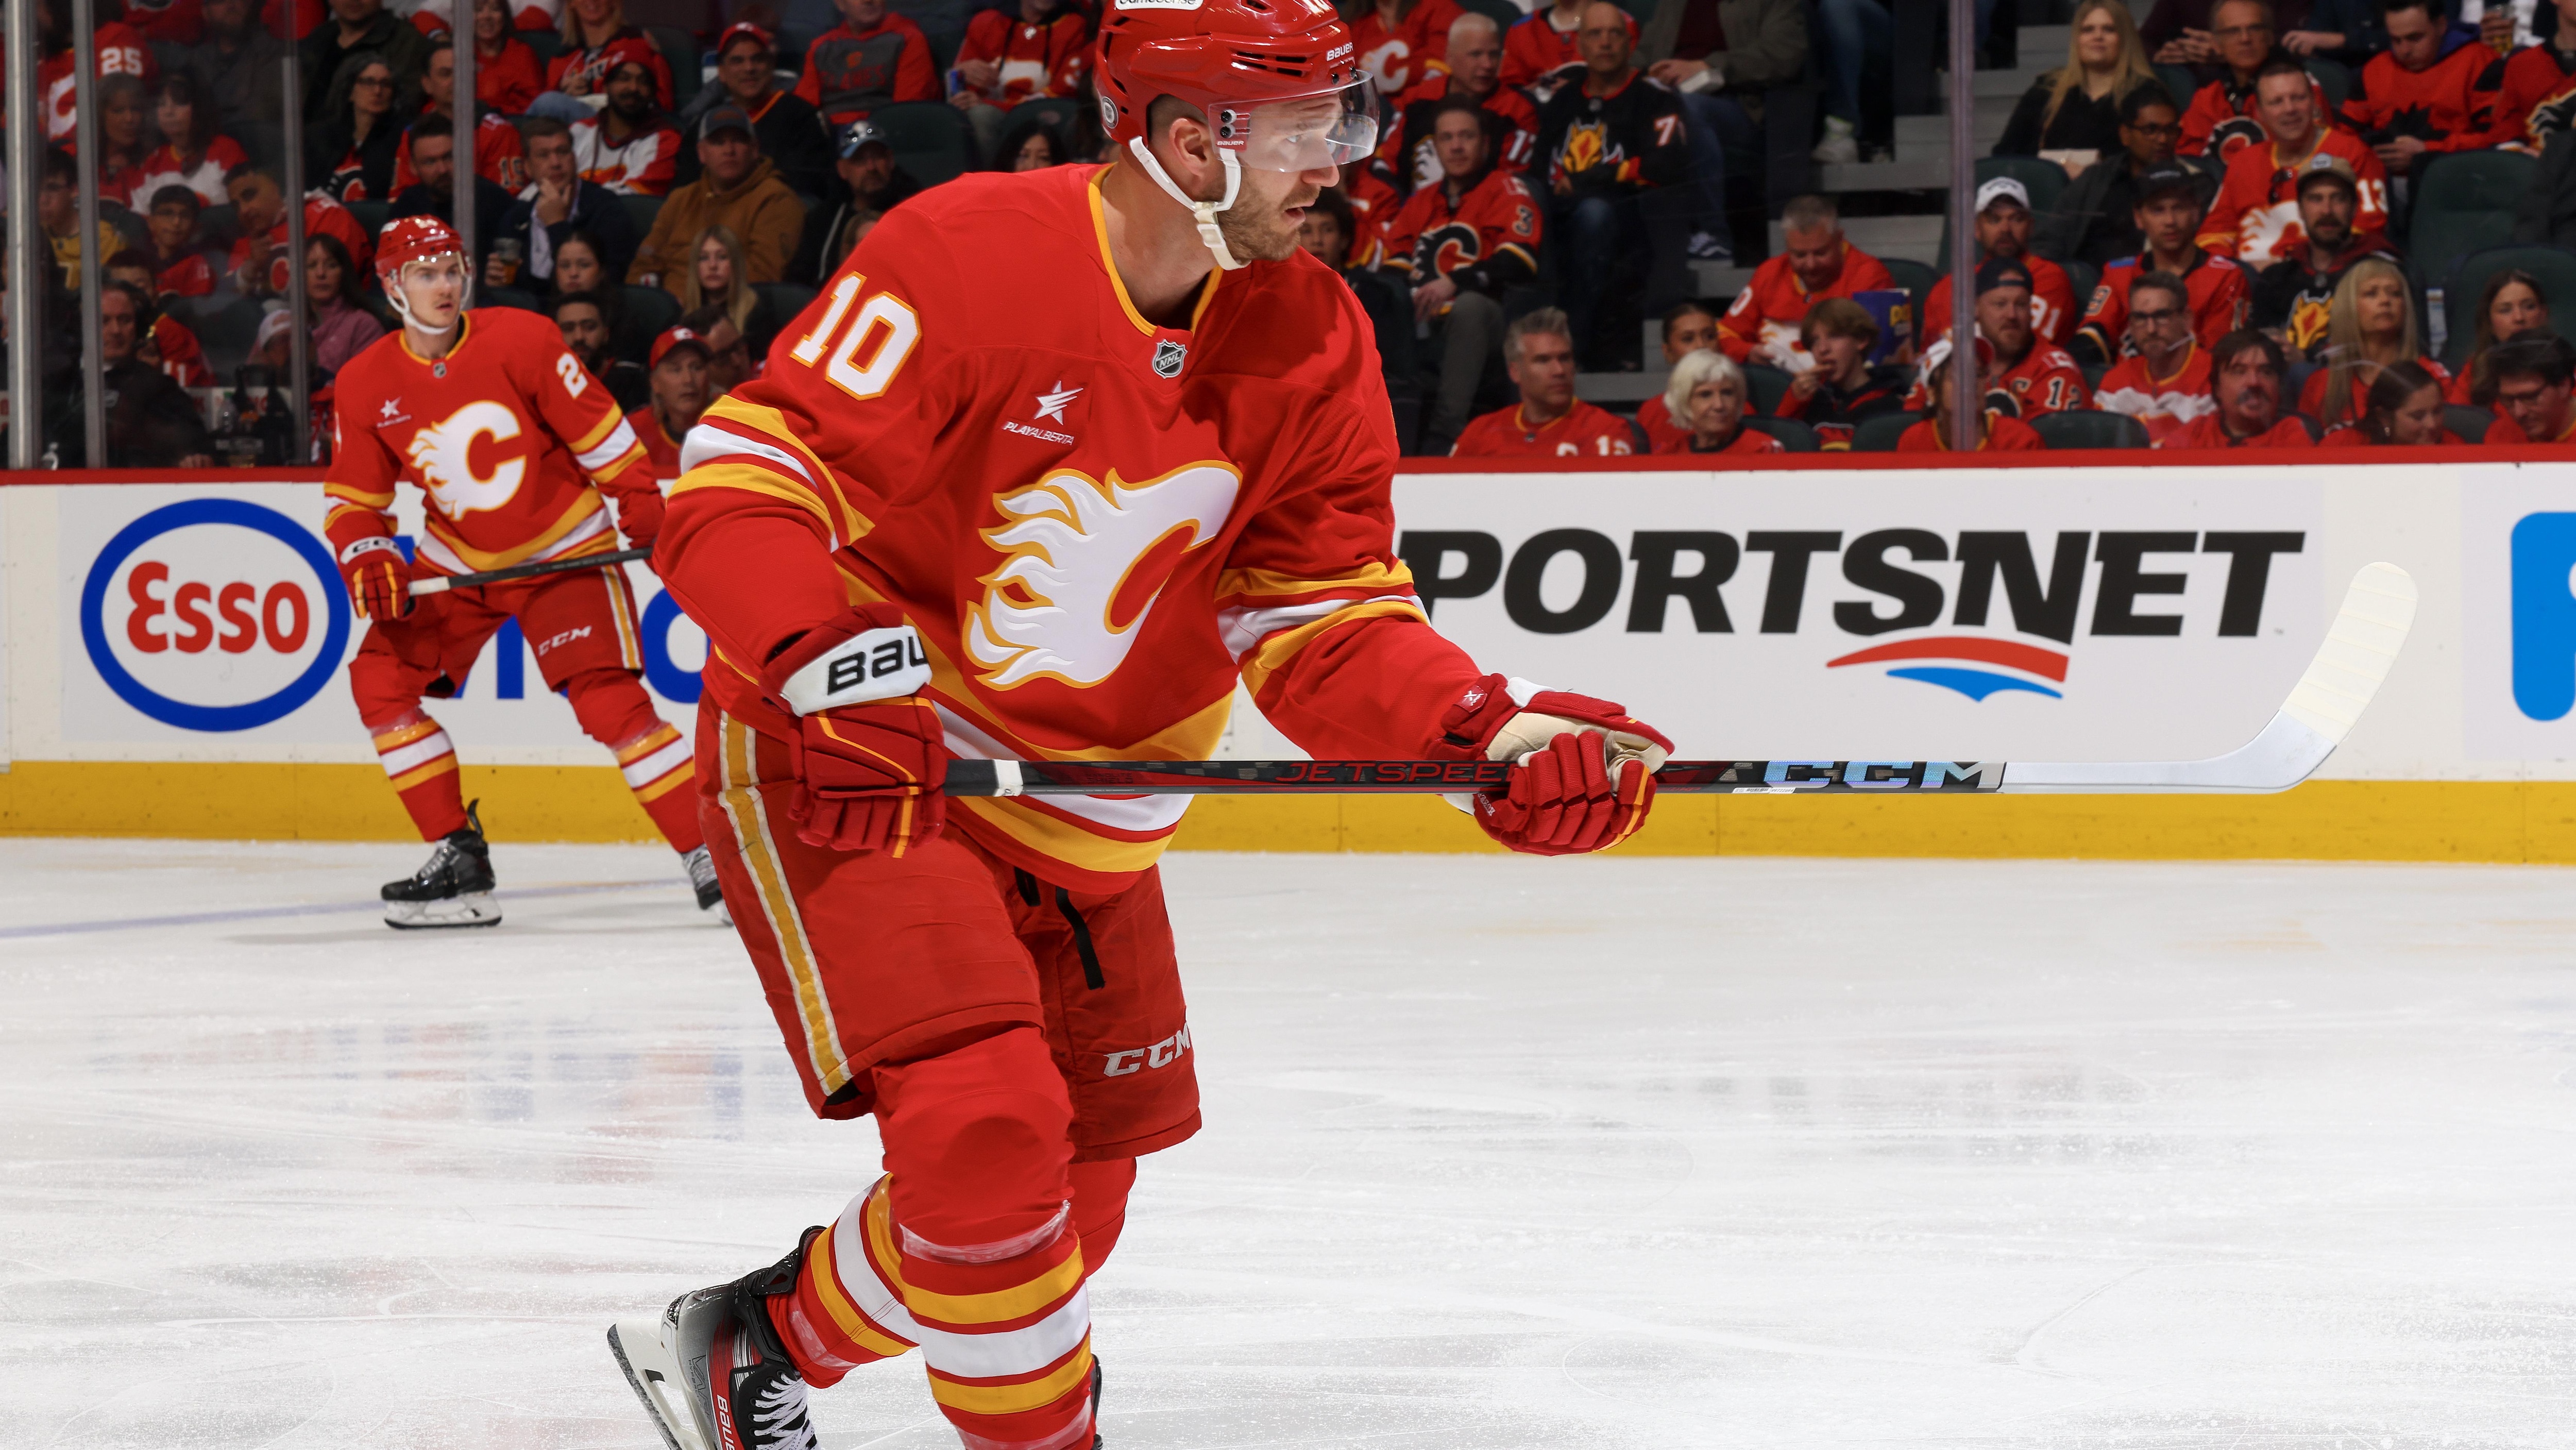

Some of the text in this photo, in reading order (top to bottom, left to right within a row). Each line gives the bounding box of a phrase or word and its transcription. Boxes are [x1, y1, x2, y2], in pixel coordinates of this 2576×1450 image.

[100, 47, 144, 75] 25
[1326, 42, 1354, 61] BAUER
[789, 271, 923, 401] 10
[1159, 353, 1181, 368] NHL
[1003, 420, 1075, 446] PLAYALBERTA
[127, 560, 310, 654] Esso
[538, 625, 592, 657] CCM
[1764, 761, 2003, 788] CCM
[1103, 1021, 1191, 1077] CCM
